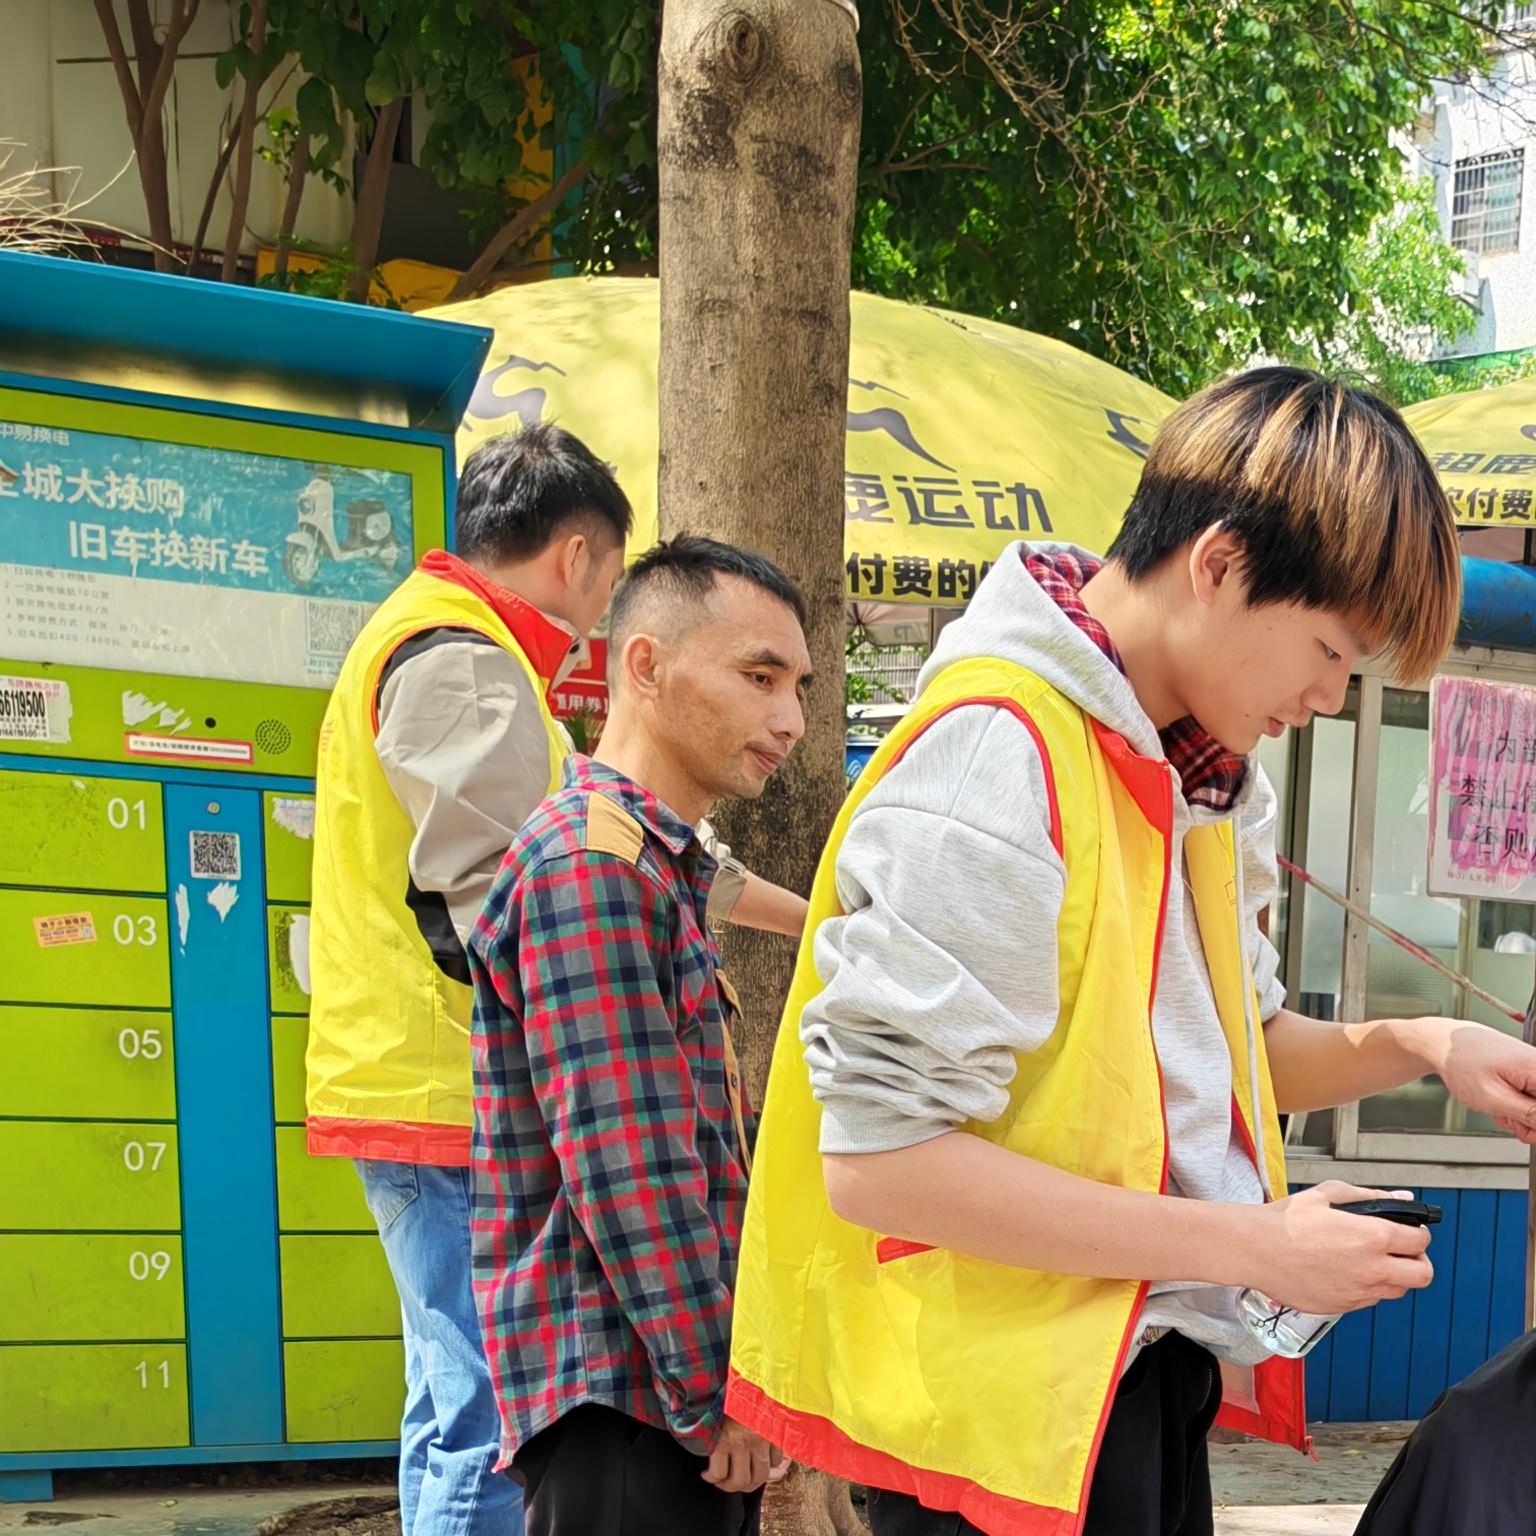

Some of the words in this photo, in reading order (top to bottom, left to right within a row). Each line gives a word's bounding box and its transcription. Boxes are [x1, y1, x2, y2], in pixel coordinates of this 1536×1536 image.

[68, 520, 270, 578] 旧车换新车
[107, 797, 146, 831] 01
[113, 914, 157, 946] 03
[118, 1028, 162, 1060] 05
[123, 1141, 167, 1172] 07
[128, 1251, 171, 1281] 09
[134, 1360, 171, 1389] 11
